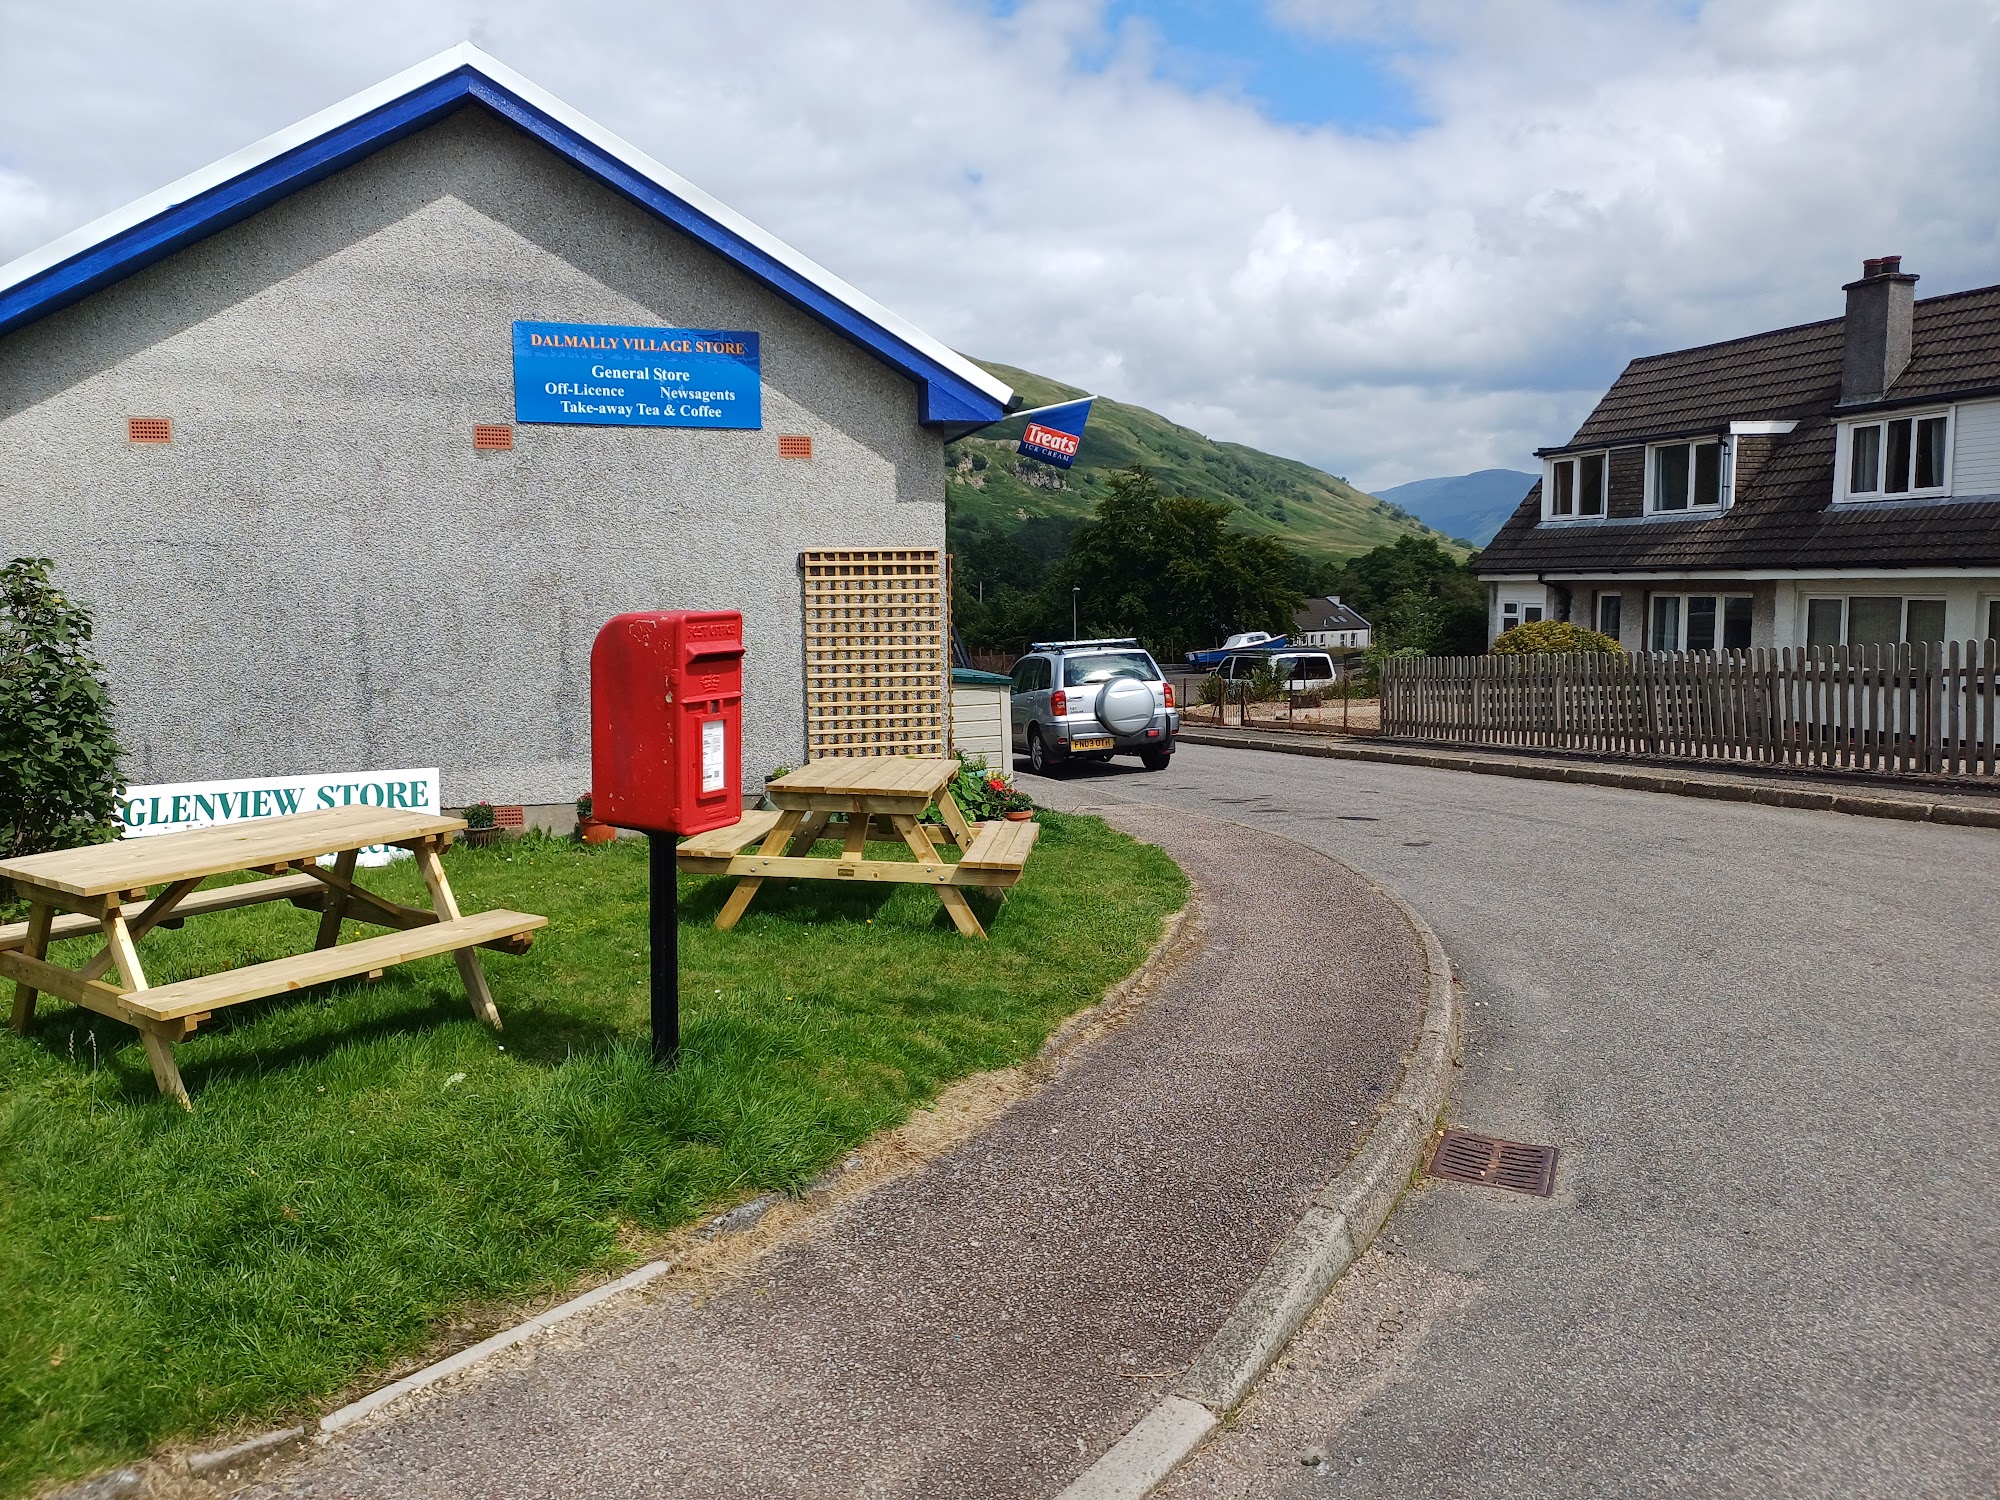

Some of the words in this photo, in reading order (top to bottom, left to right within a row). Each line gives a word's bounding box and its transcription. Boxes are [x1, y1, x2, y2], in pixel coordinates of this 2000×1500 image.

[531, 333, 619, 350] DALMALLY
[622, 338, 692, 354] VILLAGE
[695, 341, 746, 355] STORE
[591, 365, 649, 380] General
[653, 367, 690, 382] Store
[545, 382, 625, 397] Off-Licence
[660, 386, 736, 402] Newsagents
[560, 400, 633, 418] Take-away
[636, 403, 660, 416] Tea
[663, 404, 676, 416] &
[679, 404, 722, 418] Coffee
[1028, 424, 1077, 454] Treats
[1025, 443, 1040, 453] ICE
[1042, 448, 1070, 462] CREAM
[122, 787, 306, 827] GLENVIEW
[316, 780, 429, 811] STORE
